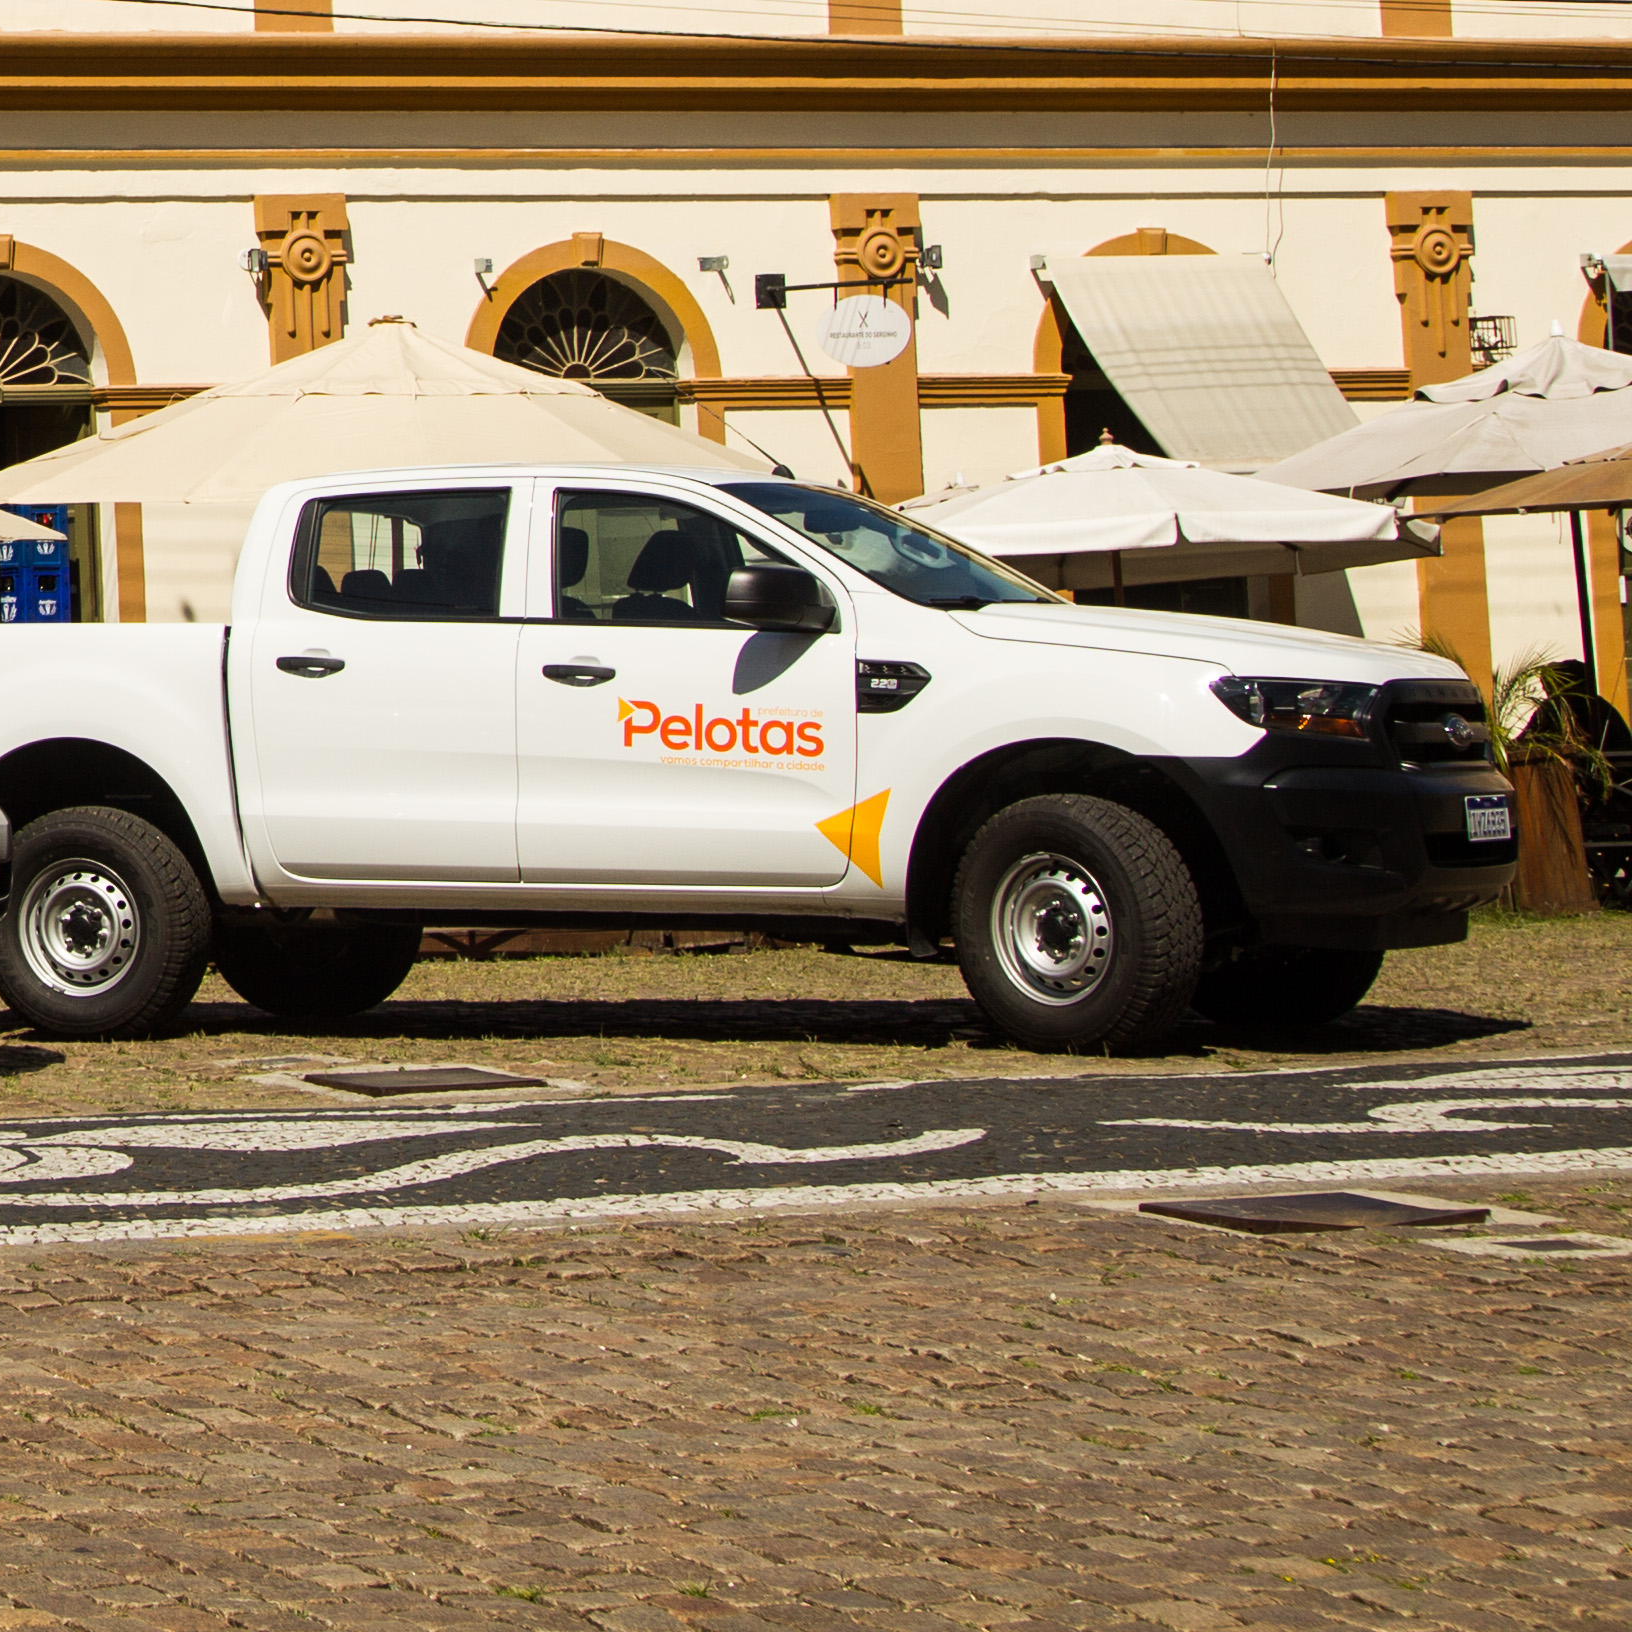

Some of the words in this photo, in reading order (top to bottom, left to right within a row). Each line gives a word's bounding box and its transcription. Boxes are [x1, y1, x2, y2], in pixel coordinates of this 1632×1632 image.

[622, 700, 825, 758] Pelotas
[660, 755, 697, 766] vamos
[699, 756, 774, 770] compartilhar
[786, 760, 825, 772] cidade
